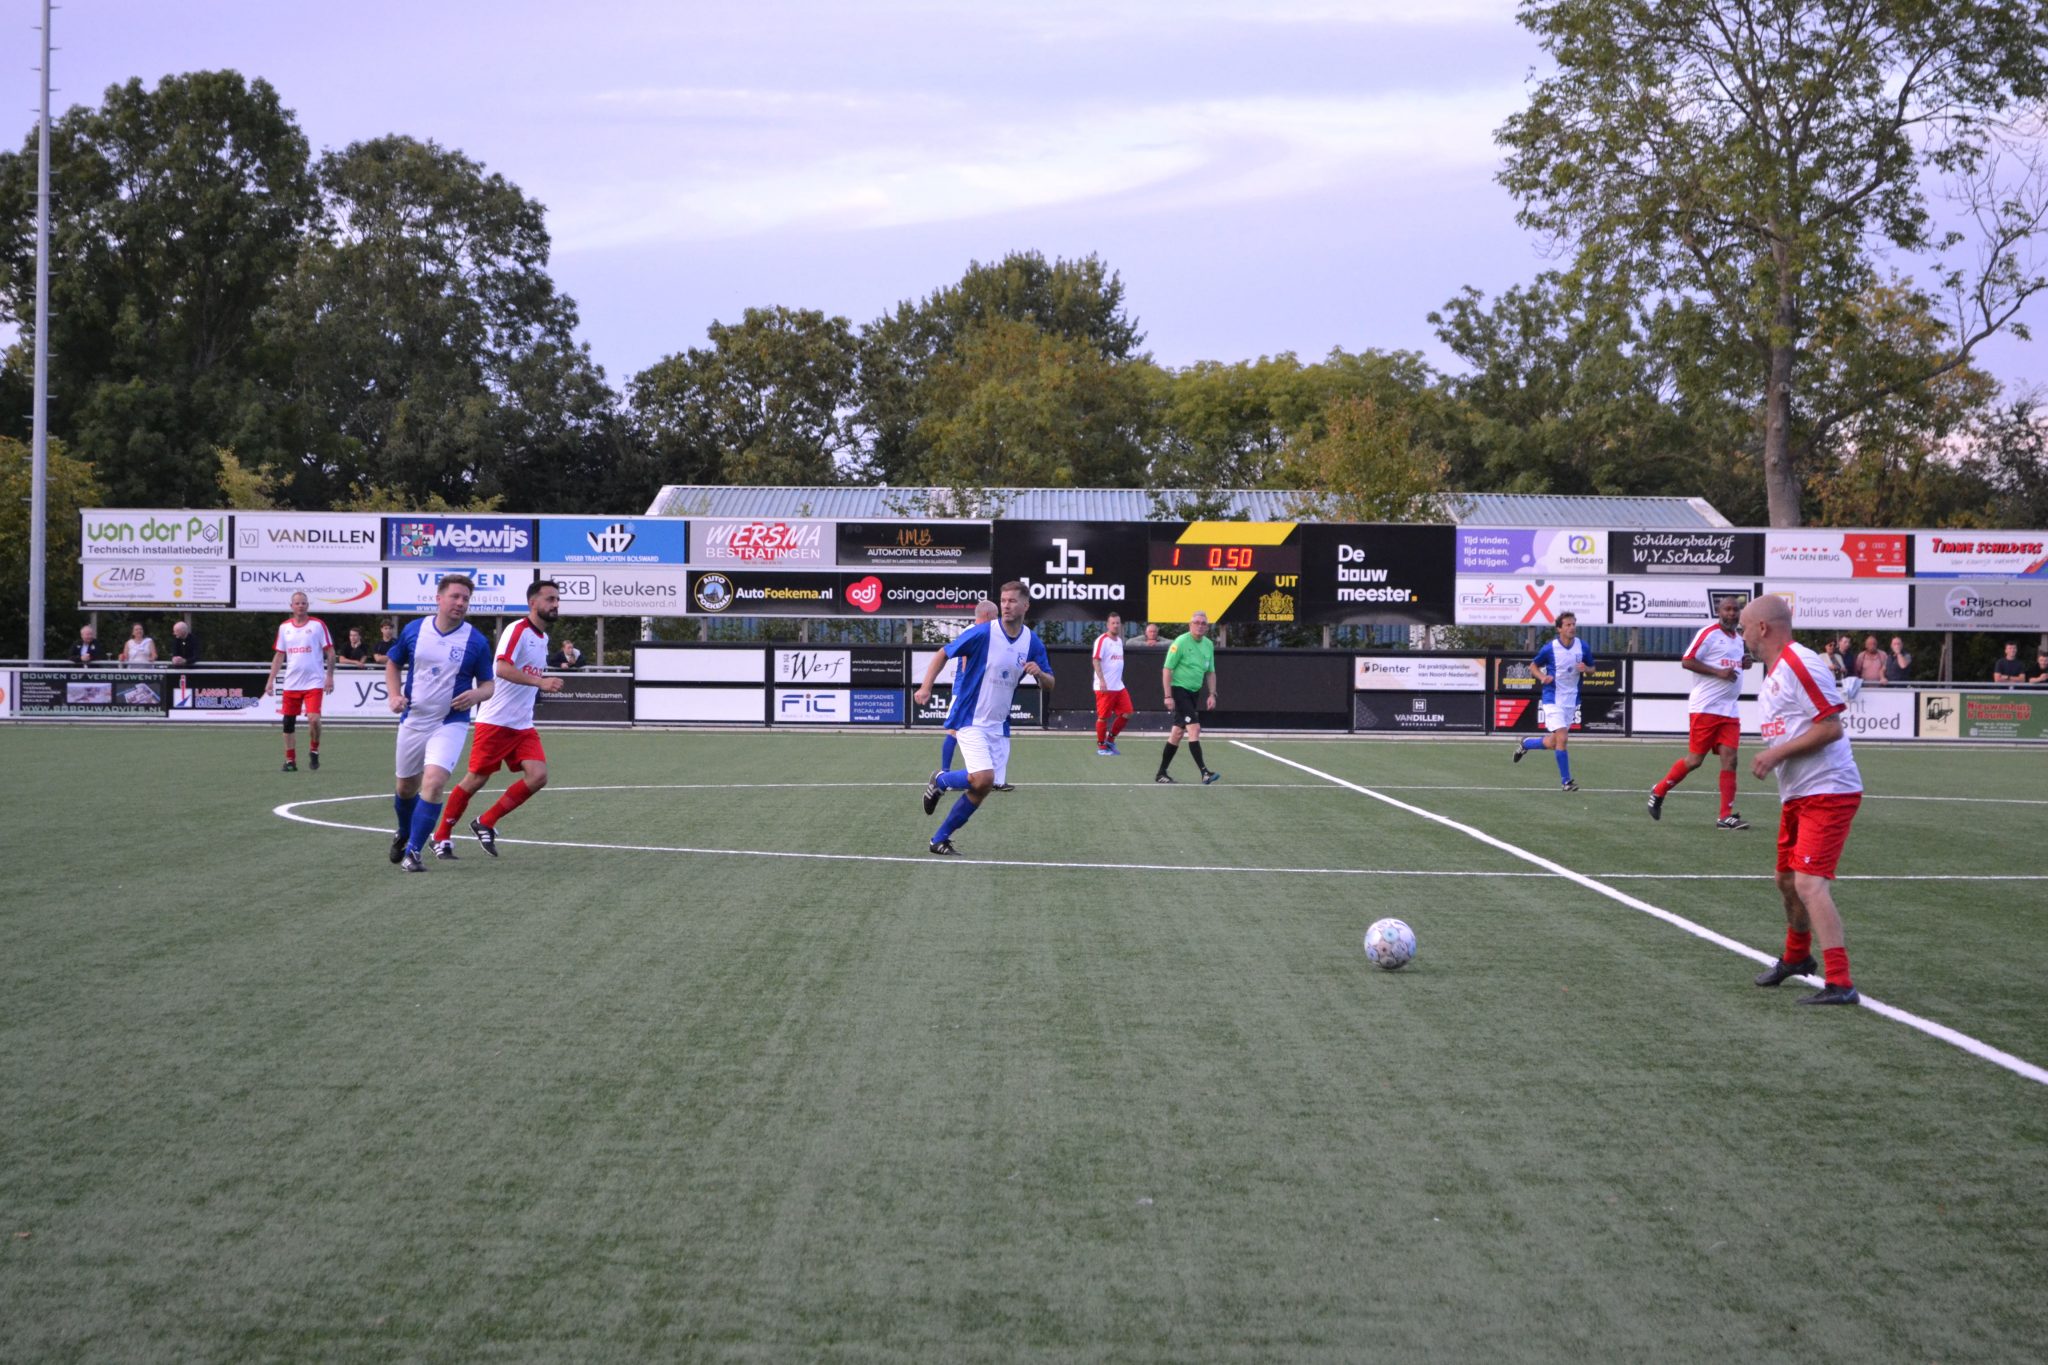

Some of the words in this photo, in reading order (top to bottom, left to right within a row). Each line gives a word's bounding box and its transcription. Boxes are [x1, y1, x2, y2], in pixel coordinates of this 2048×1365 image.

[88, 523, 134, 542] van
[187, 516, 223, 542] Pol
[706, 524, 821, 547] WIERSMA
[267, 529, 375, 544] VANDILLEN
[432, 524, 529, 553] Webwijs
[1464, 535, 1478, 546] Tijd
[1632, 535, 1736, 550] Schildersbedrijf
[88, 545, 140, 554] Technisch
[143, 545, 223, 556] installatiebedrijf
[706, 547, 820, 559] BESTRATINGEN
[867, 548, 918, 557] AUTOMOTIVE
[920, 549, 963, 557] BOLSWARD
[1338, 544, 1365, 562] De
[1464, 547, 1478, 557] tijd
[1632, 549, 1735, 564] W.Y.Schakel
[565, 554, 584, 562] VISSER
[585, 554, 626, 562] TRANSPORTEN
[1173, 548, 1180, 567] 1
[1208, 548, 1223, 568] 0
[1226, 548, 1253, 568] 50
[1464, 558, 1478, 568] tijd
[1818, 554, 1840, 562] BRUG
[109, 567, 146, 582] ZMB
[241, 571, 305, 583] DINKLA
[1338, 564, 1387, 582] bouw
[703, 575, 726, 585] AUTO
[1152, 574, 1192, 586] THUIS
[1211, 575, 1238, 586] MIN
[1275, 575, 1298, 588] UIT
[258, 586, 358, 594] verkeersopleidingen
[558, 581, 590, 595] BKB
[603, 580, 677, 596] keukens
[735, 587, 833, 600] AutoFoekema.nl
[851, 584, 878, 604] odj
[1338, 586, 1418, 602] meester.
[697, 593, 731, 609] FOEKEMA
[886, 587, 988, 603] osingadejong
[1462, 595, 1520, 605] FlexFirst
[1647, 597, 1707, 609] aluminiumbouw
[1966, 597, 2032, 608] Rijschool
[1798, 607, 1830, 618] Julius
[1833, 609, 1852, 618] van
[1855, 607, 1873, 618] der
[1876, 607, 1904, 619] Werf
[1952, 607, 1994, 618] Richard
[791, 651, 845, 681] Werf
[1371, 663, 1411, 674] Pienter
[1395, 714, 1445, 722] VANDILLEN
